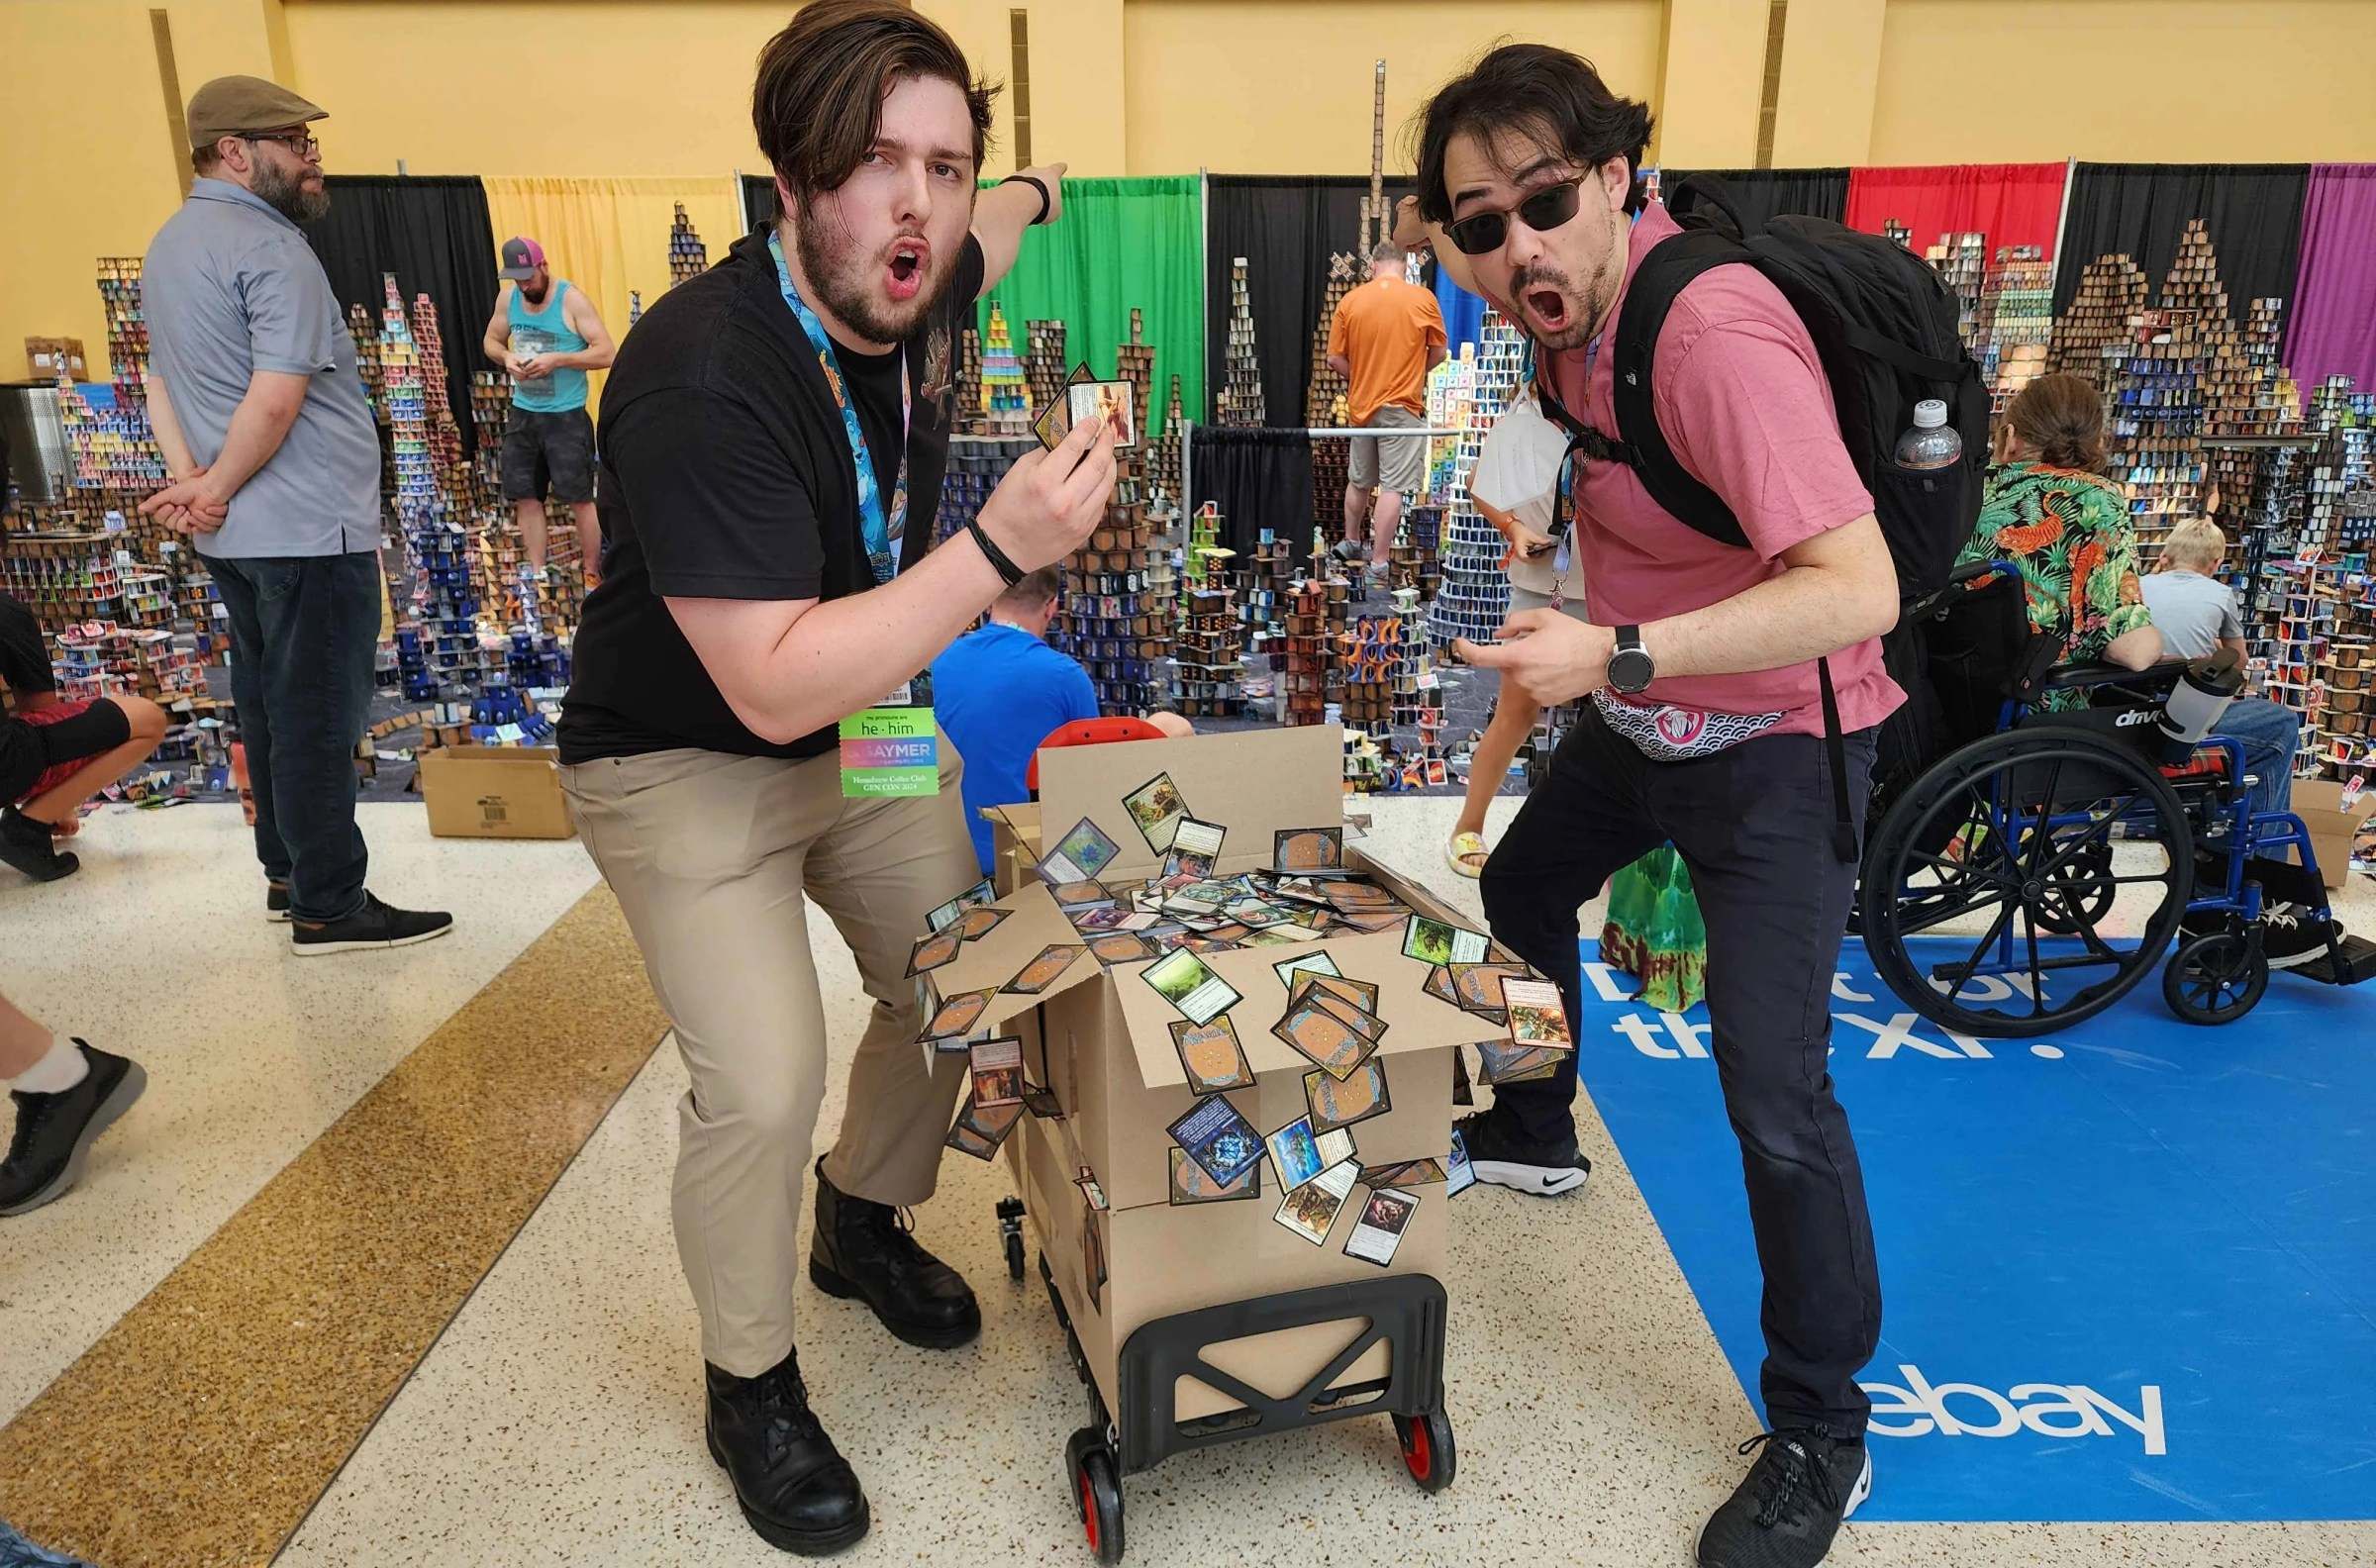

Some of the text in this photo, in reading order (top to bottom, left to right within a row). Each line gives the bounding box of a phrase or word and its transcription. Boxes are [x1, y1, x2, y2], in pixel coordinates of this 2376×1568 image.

[861, 721, 914, 735] he him
[866, 742, 931, 757] AYMER
[1857, 1364, 2167, 1455] ebay
